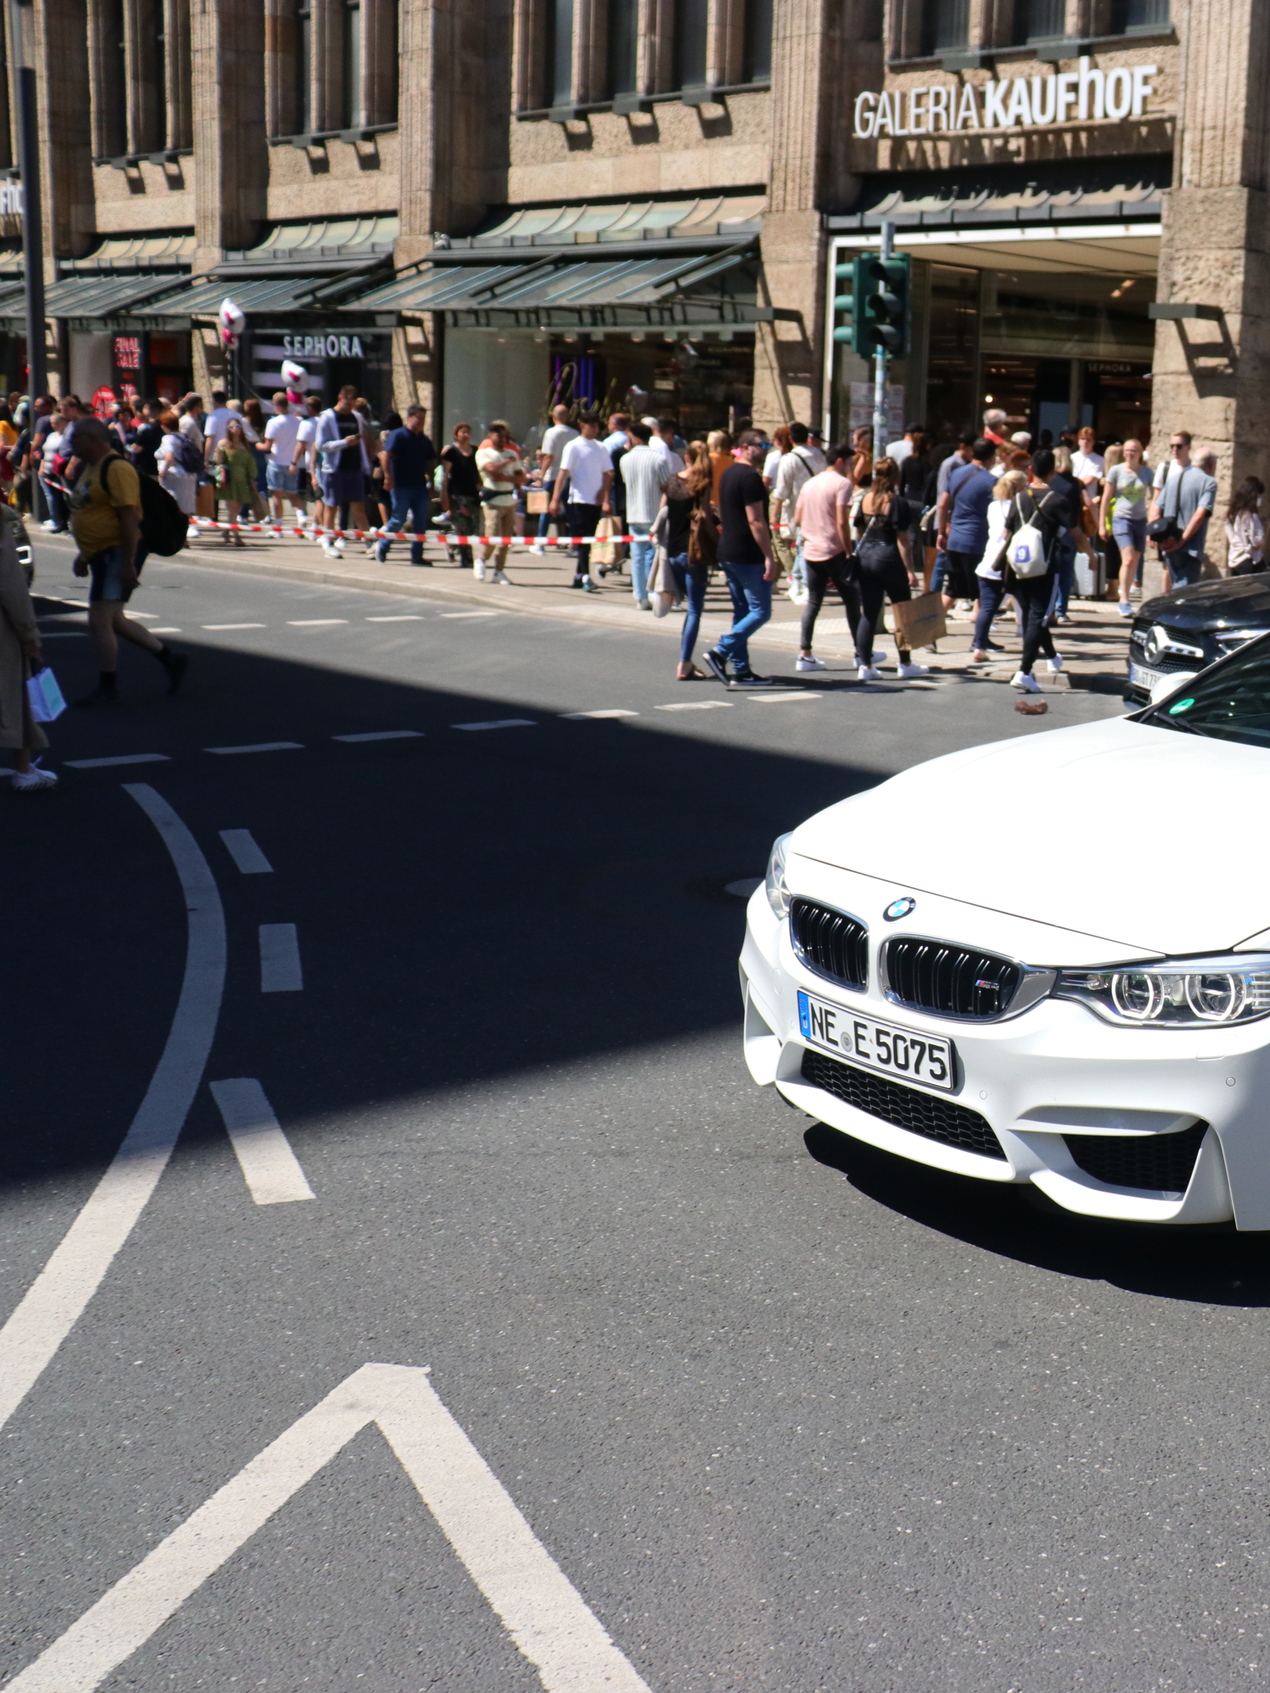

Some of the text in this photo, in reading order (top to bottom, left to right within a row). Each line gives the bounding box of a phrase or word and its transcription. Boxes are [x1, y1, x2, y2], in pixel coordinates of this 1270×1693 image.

[854, 82, 980, 139] GALERIA
[283, 334, 365, 358] SEPHORA
[810, 1002, 839, 1047] NE
[853, 1020, 871, 1059] E
[875, 1028, 948, 1081] 5075
